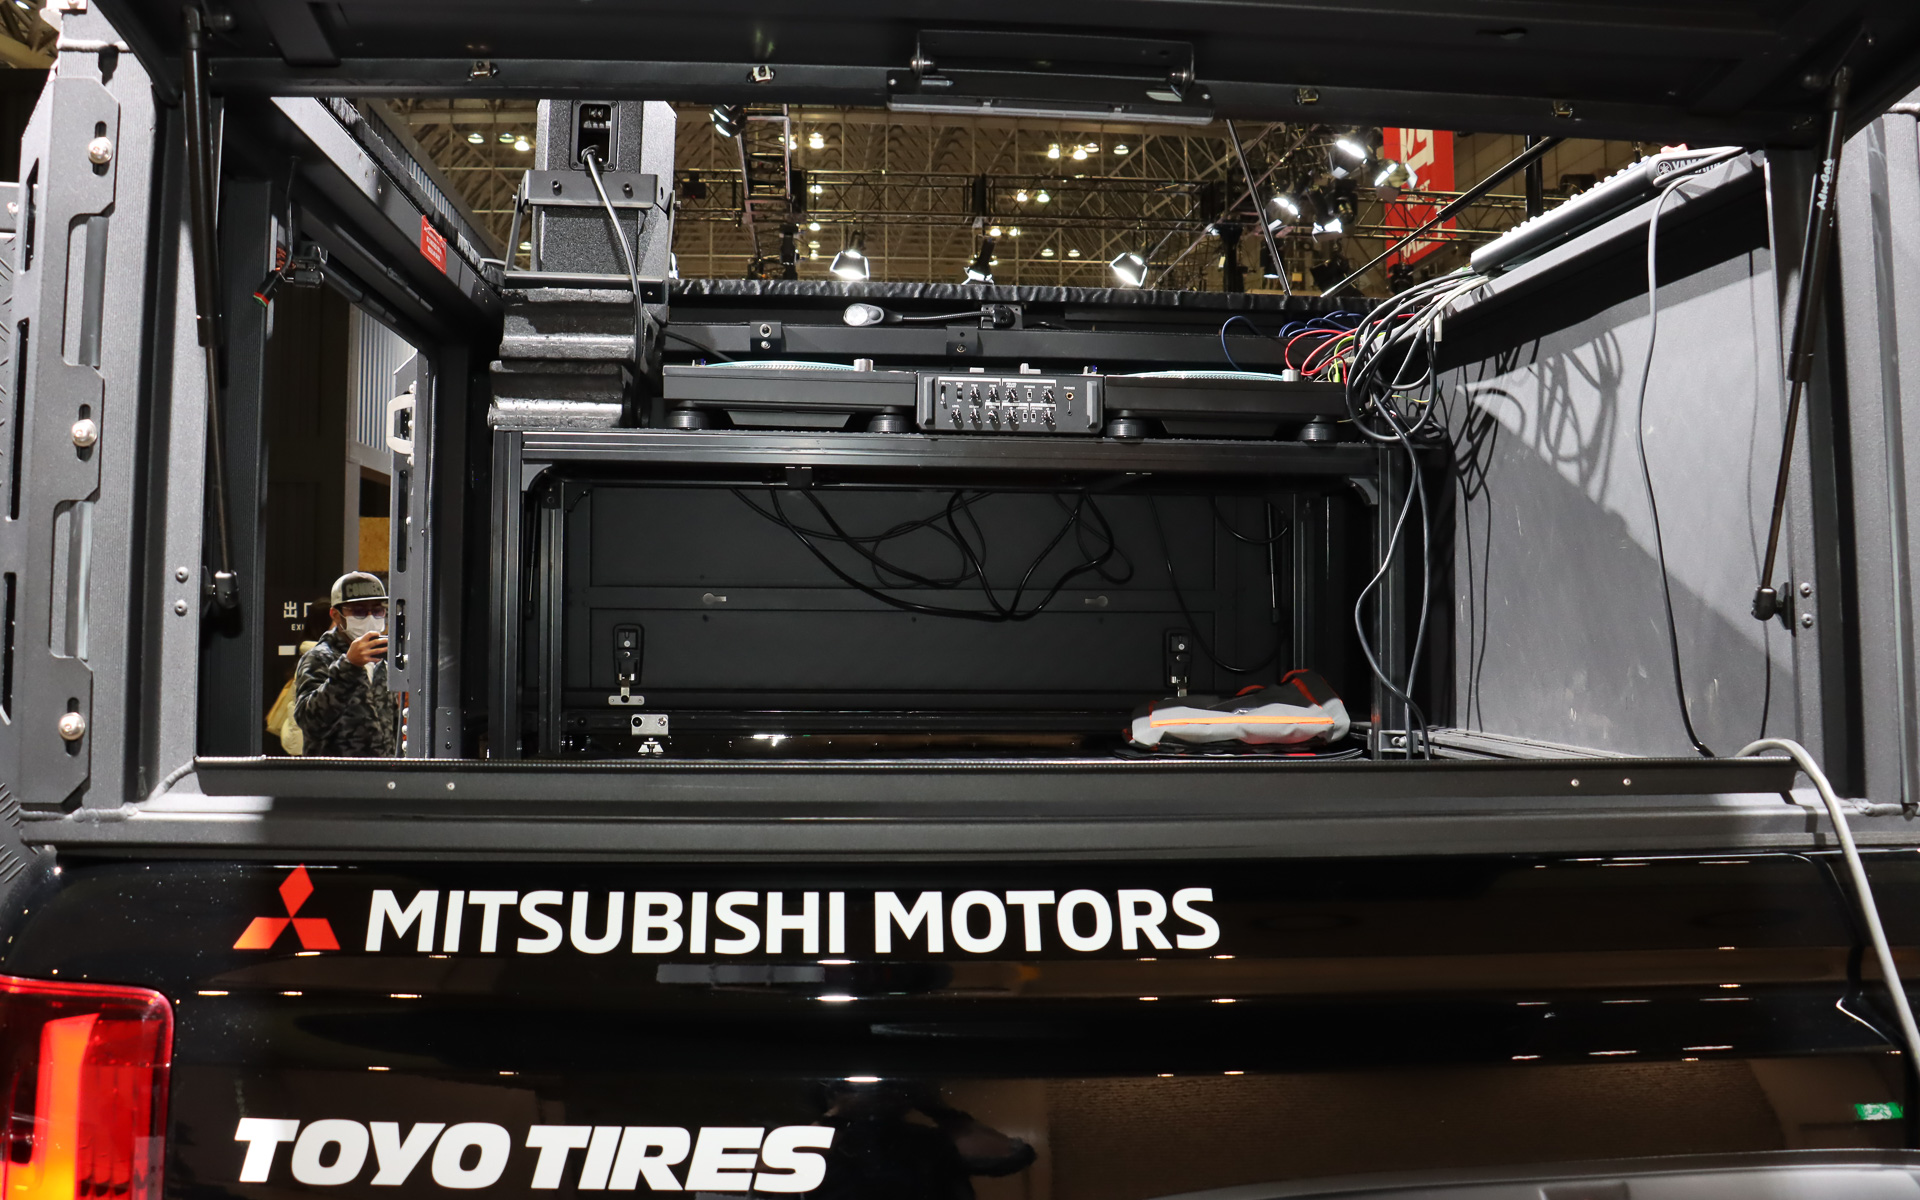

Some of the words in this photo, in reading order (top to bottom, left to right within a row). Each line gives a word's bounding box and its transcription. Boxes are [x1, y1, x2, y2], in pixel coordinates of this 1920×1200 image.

[291, 623, 305, 631] EXI
[366, 890, 845, 954] MITSUBISHI
[875, 887, 1220, 954] MOTORS
[235, 1117, 511, 1189] TOYO
[525, 1125, 836, 1193] TIRES
